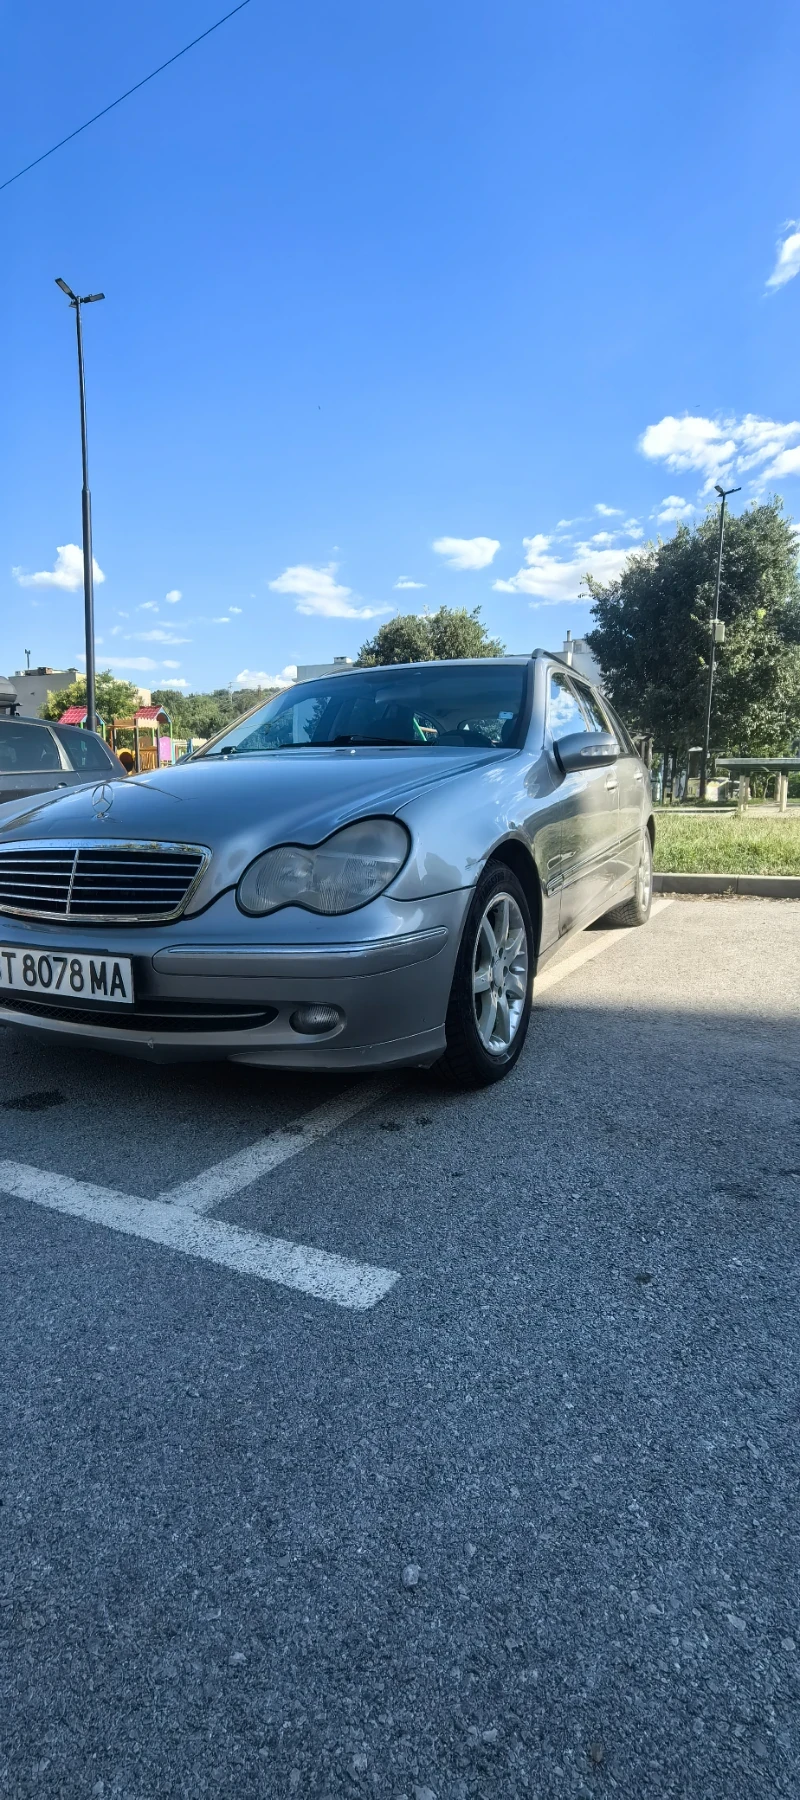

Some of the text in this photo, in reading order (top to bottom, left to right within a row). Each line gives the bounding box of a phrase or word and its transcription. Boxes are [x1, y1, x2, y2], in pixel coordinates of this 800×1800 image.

[0, 951, 127, 998] T 8078 MA
